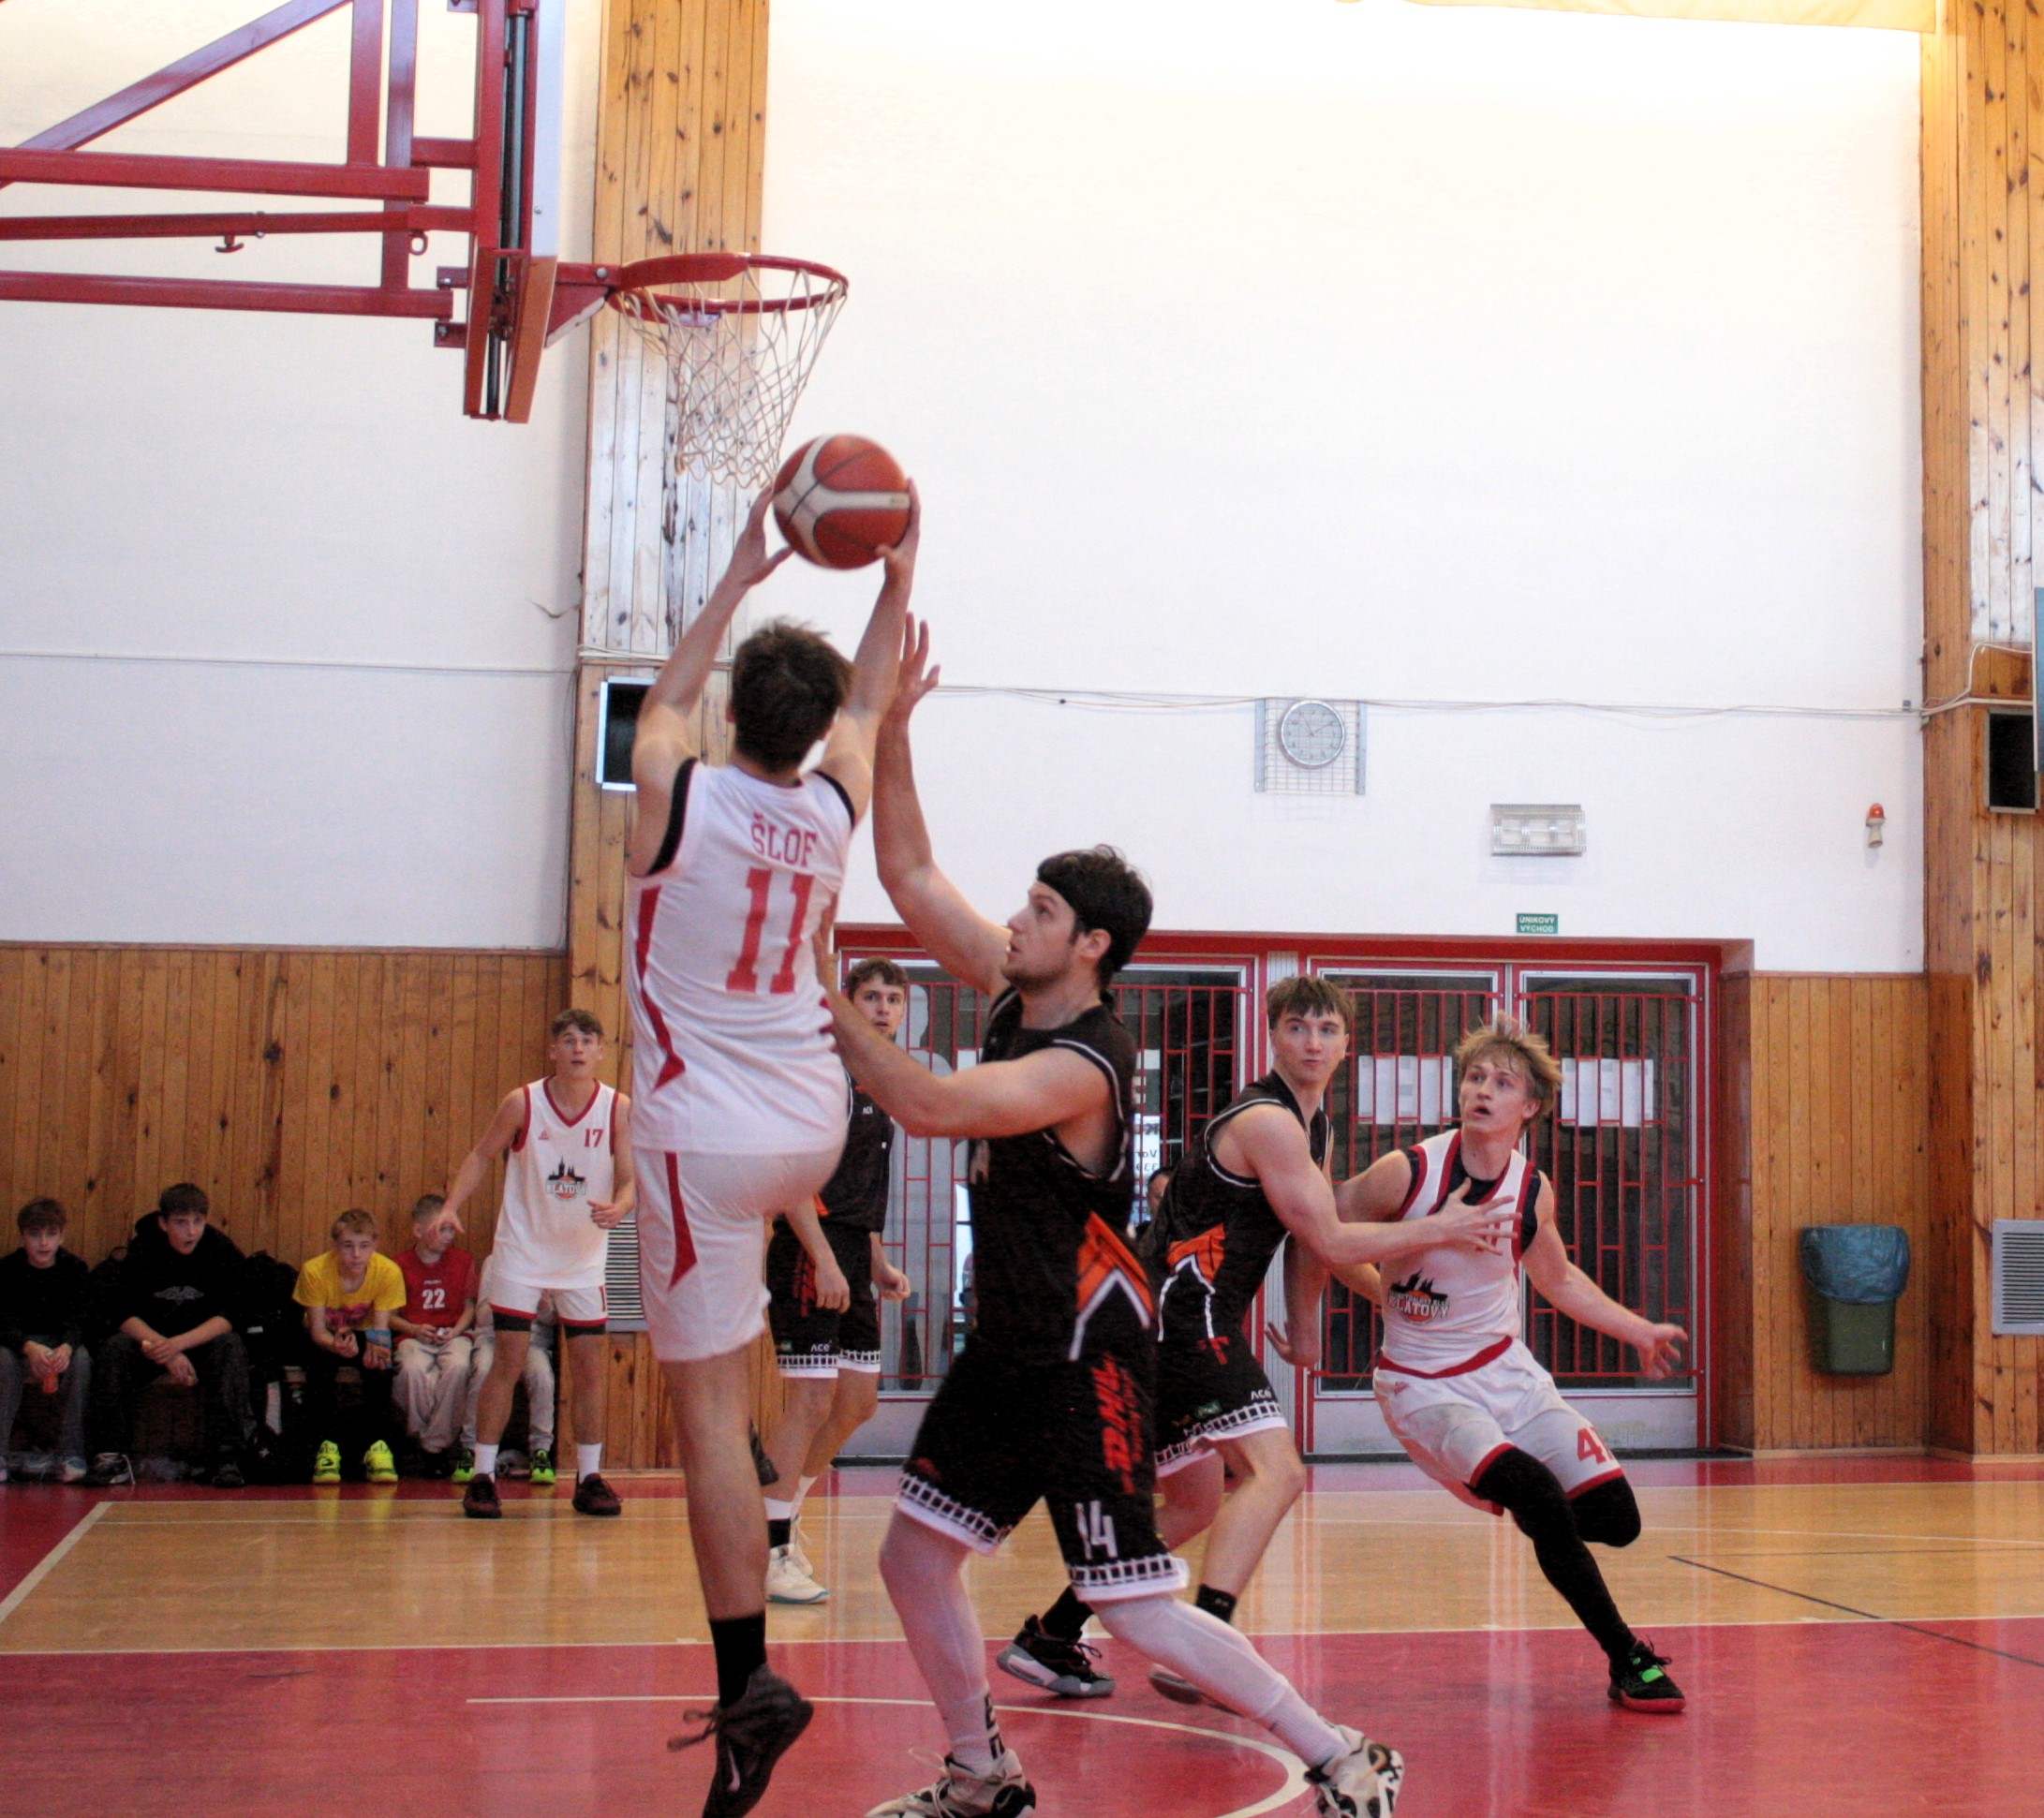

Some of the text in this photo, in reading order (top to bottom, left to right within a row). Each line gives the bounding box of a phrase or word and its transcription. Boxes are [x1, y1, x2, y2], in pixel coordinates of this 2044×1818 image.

[751, 812, 818, 867] ŠLOF
[726, 867, 815, 994] 11
[585, 1129, 603, 1147] 17
[422, 1288, 446, 1309] 22
[1075, 1500, 1118, 1559] 14
